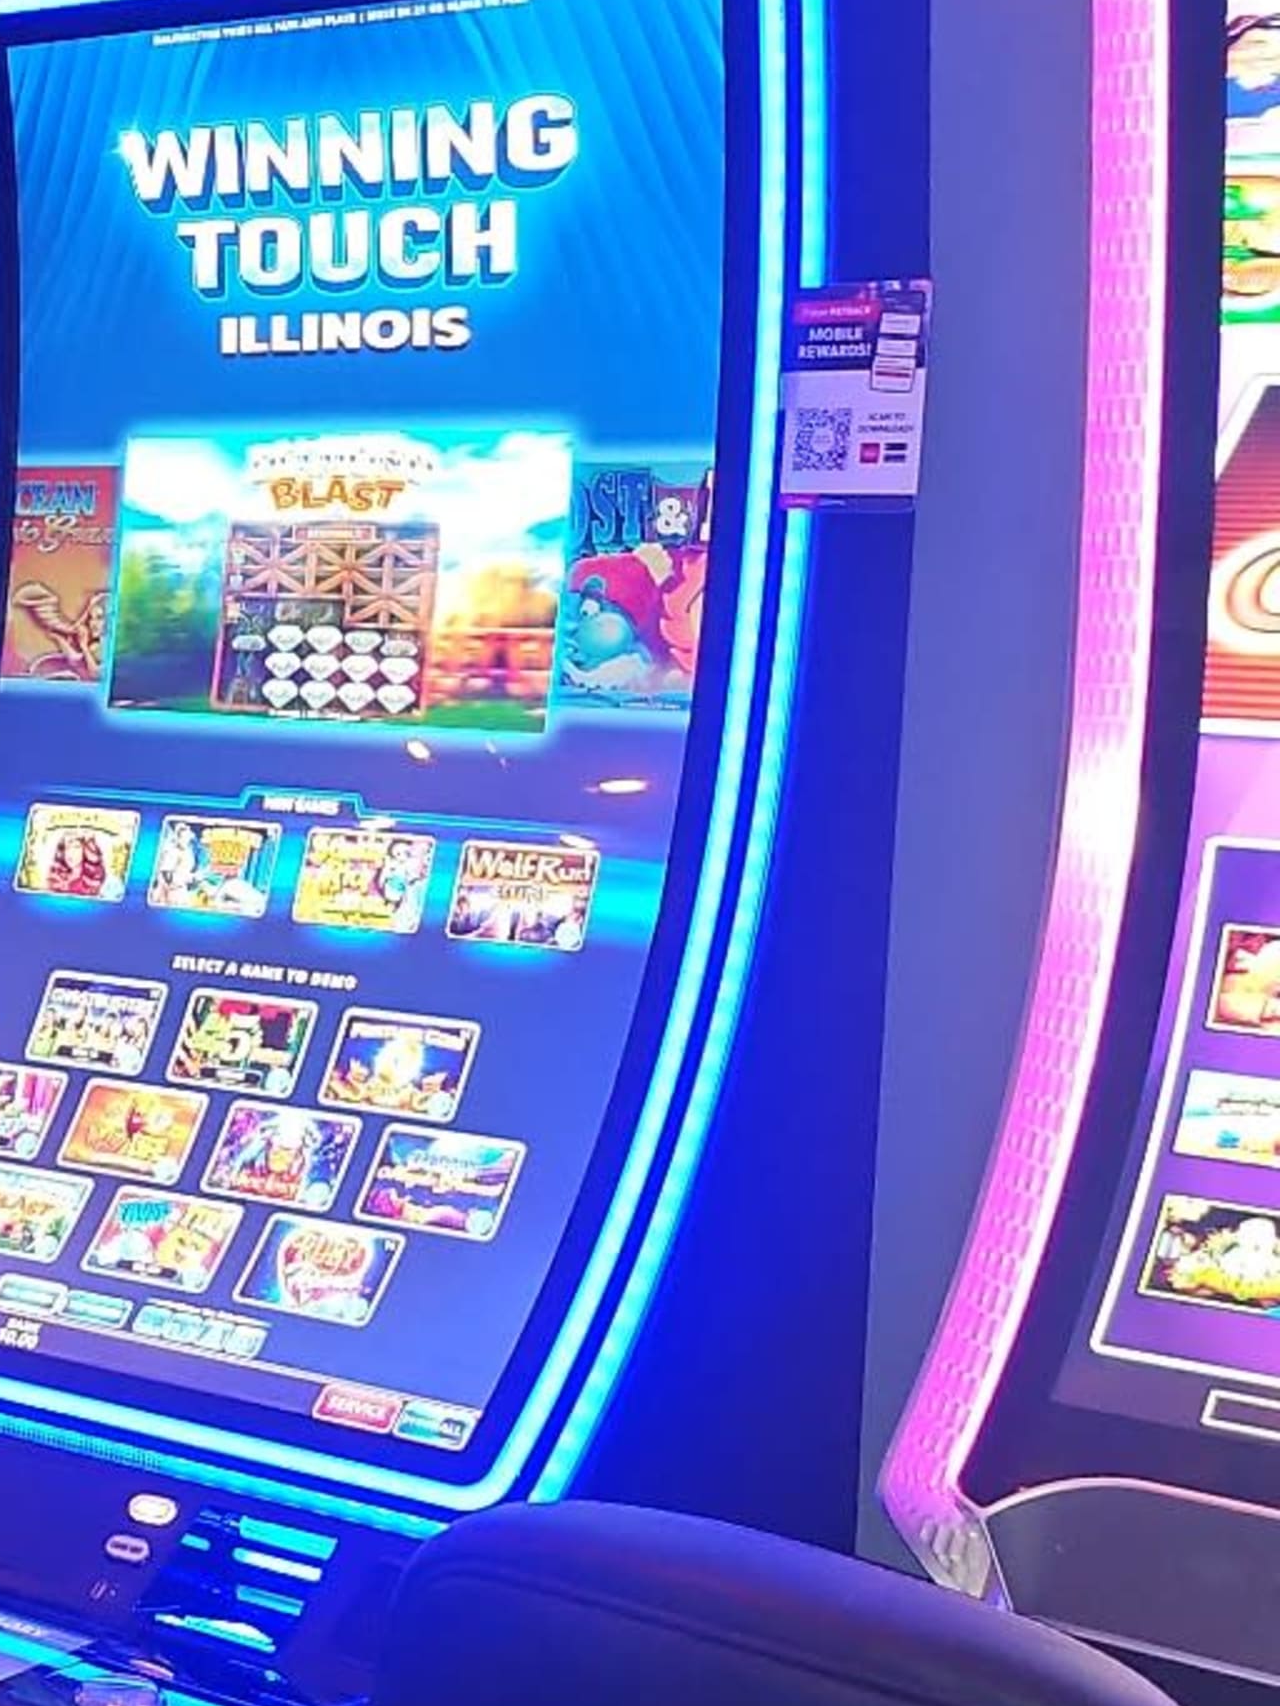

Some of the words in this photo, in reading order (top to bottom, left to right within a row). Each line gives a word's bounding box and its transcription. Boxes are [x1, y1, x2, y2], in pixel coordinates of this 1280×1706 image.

[124, 94, 579, 208] WINNING
[177, 199, 519, 297] TOUCH
[218, 306, 471, 358] ILLINOIS
[270, 474, 406, 511] BLAST
[172, 954, 225, 973] SELECT
[240, 963, 284, 983] GAME
[285, 967, 308, 984] TO
